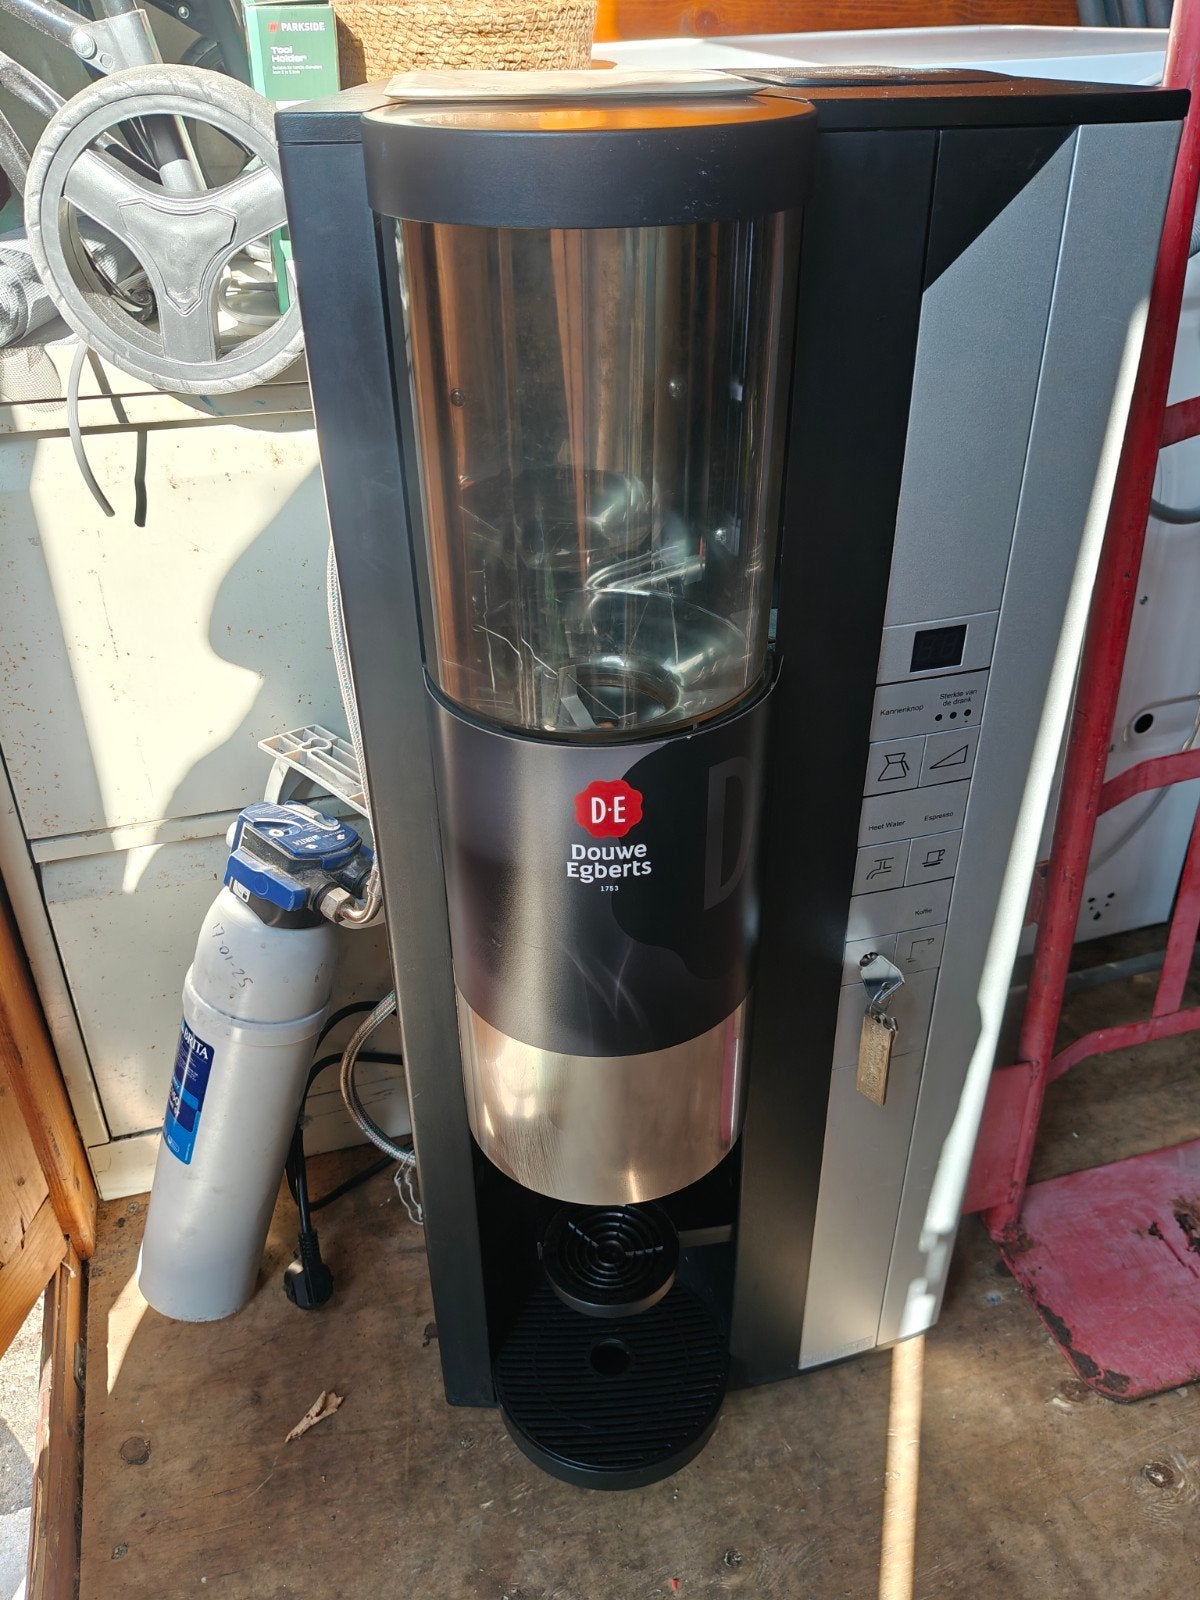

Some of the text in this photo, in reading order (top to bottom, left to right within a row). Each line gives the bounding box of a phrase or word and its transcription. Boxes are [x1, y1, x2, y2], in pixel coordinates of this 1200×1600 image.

[281, 22, 326, 32] PARKSIDE
[270, 45, 293, 55] Tool
[271, 54, 308, 63] Holder
[880, 704, 925, 716] Kannenknop
[923, 811, 954, 822] Espresso
[868, 820, 906, 831] Heet Water
[571, 843, 648, 861] Douwe
[566, 860, 653, 884] Egberts
[183, 1026, 209, 1060] BRITA
